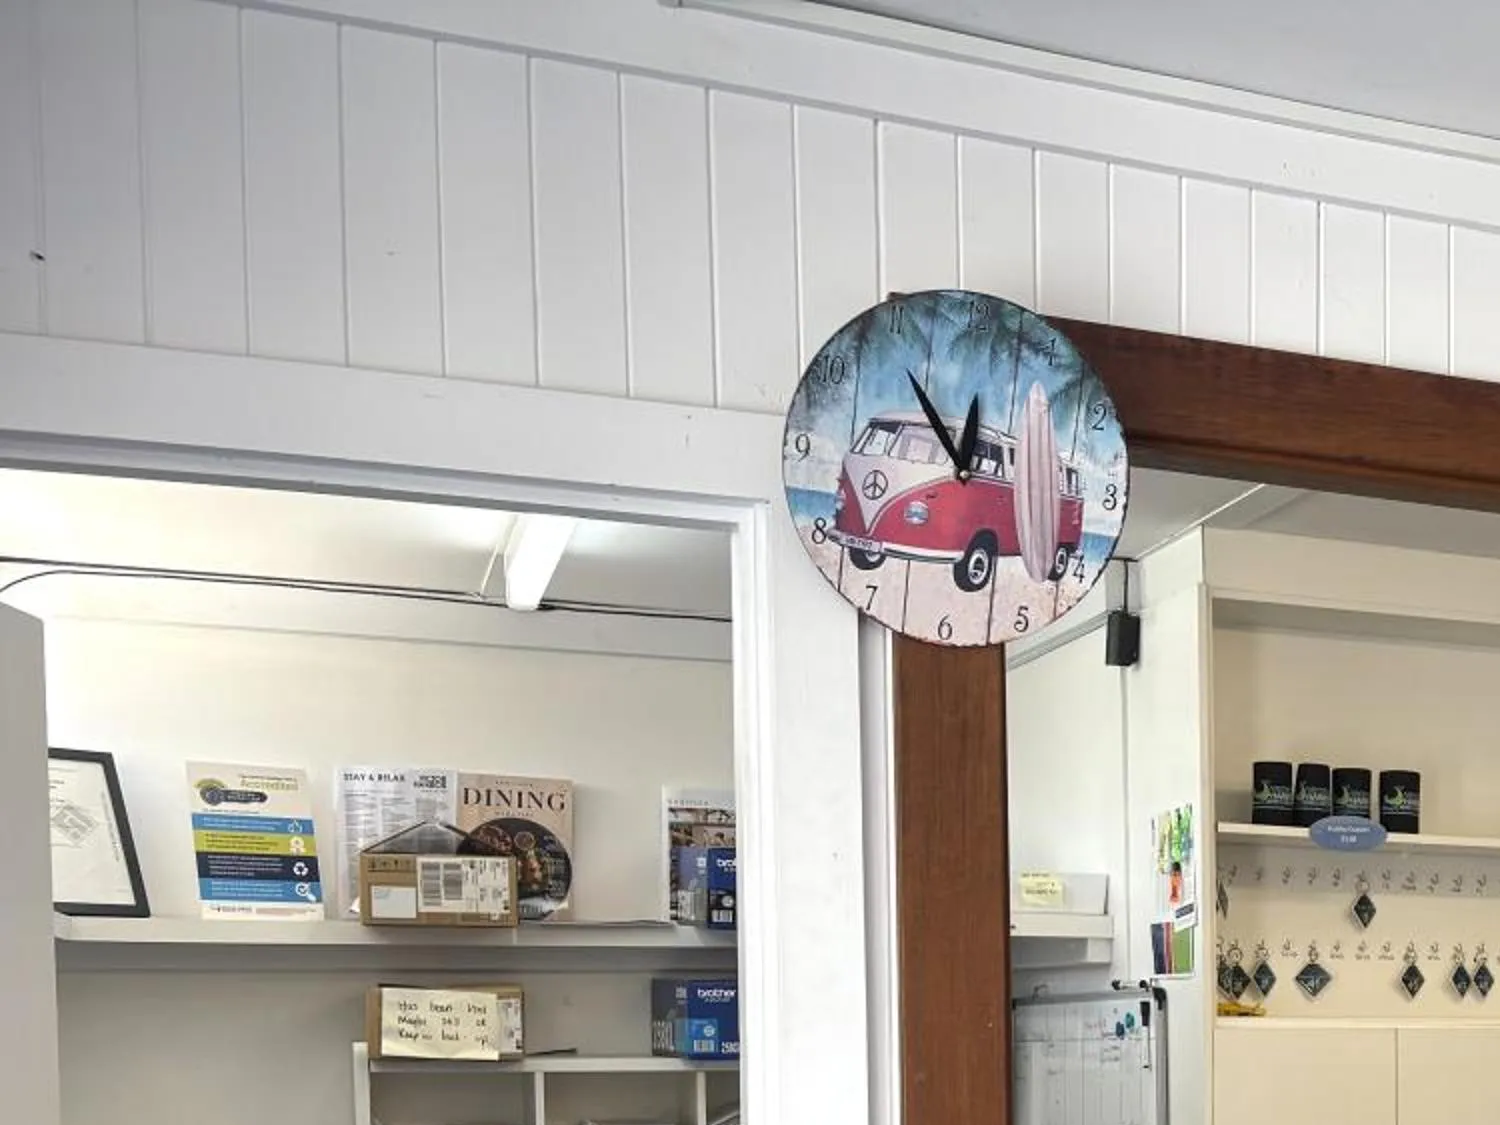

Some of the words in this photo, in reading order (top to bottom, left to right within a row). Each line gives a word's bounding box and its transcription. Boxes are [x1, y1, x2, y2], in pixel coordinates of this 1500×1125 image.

[888, 304, 904, 335] 11
[967, 301, 991, 332] 12
[1046, 337, 1058, 366] 1
[820, 353, 846, 384] 10
[1090, 402, 1108, 431] 2
[794, 433, 812, 462] 9
[1102, 484, 1118, 511] 3
[811, 518, 828, 545] 8
[1072, 557, 1087, 584] 4
[864, 585, 878, 612] 7
[937, 615, 953, 641] 6
[1013, 606, 1030, 633] 5
[463, 787, 567, 812] DINING
[697, 988, 737, 998] brother
